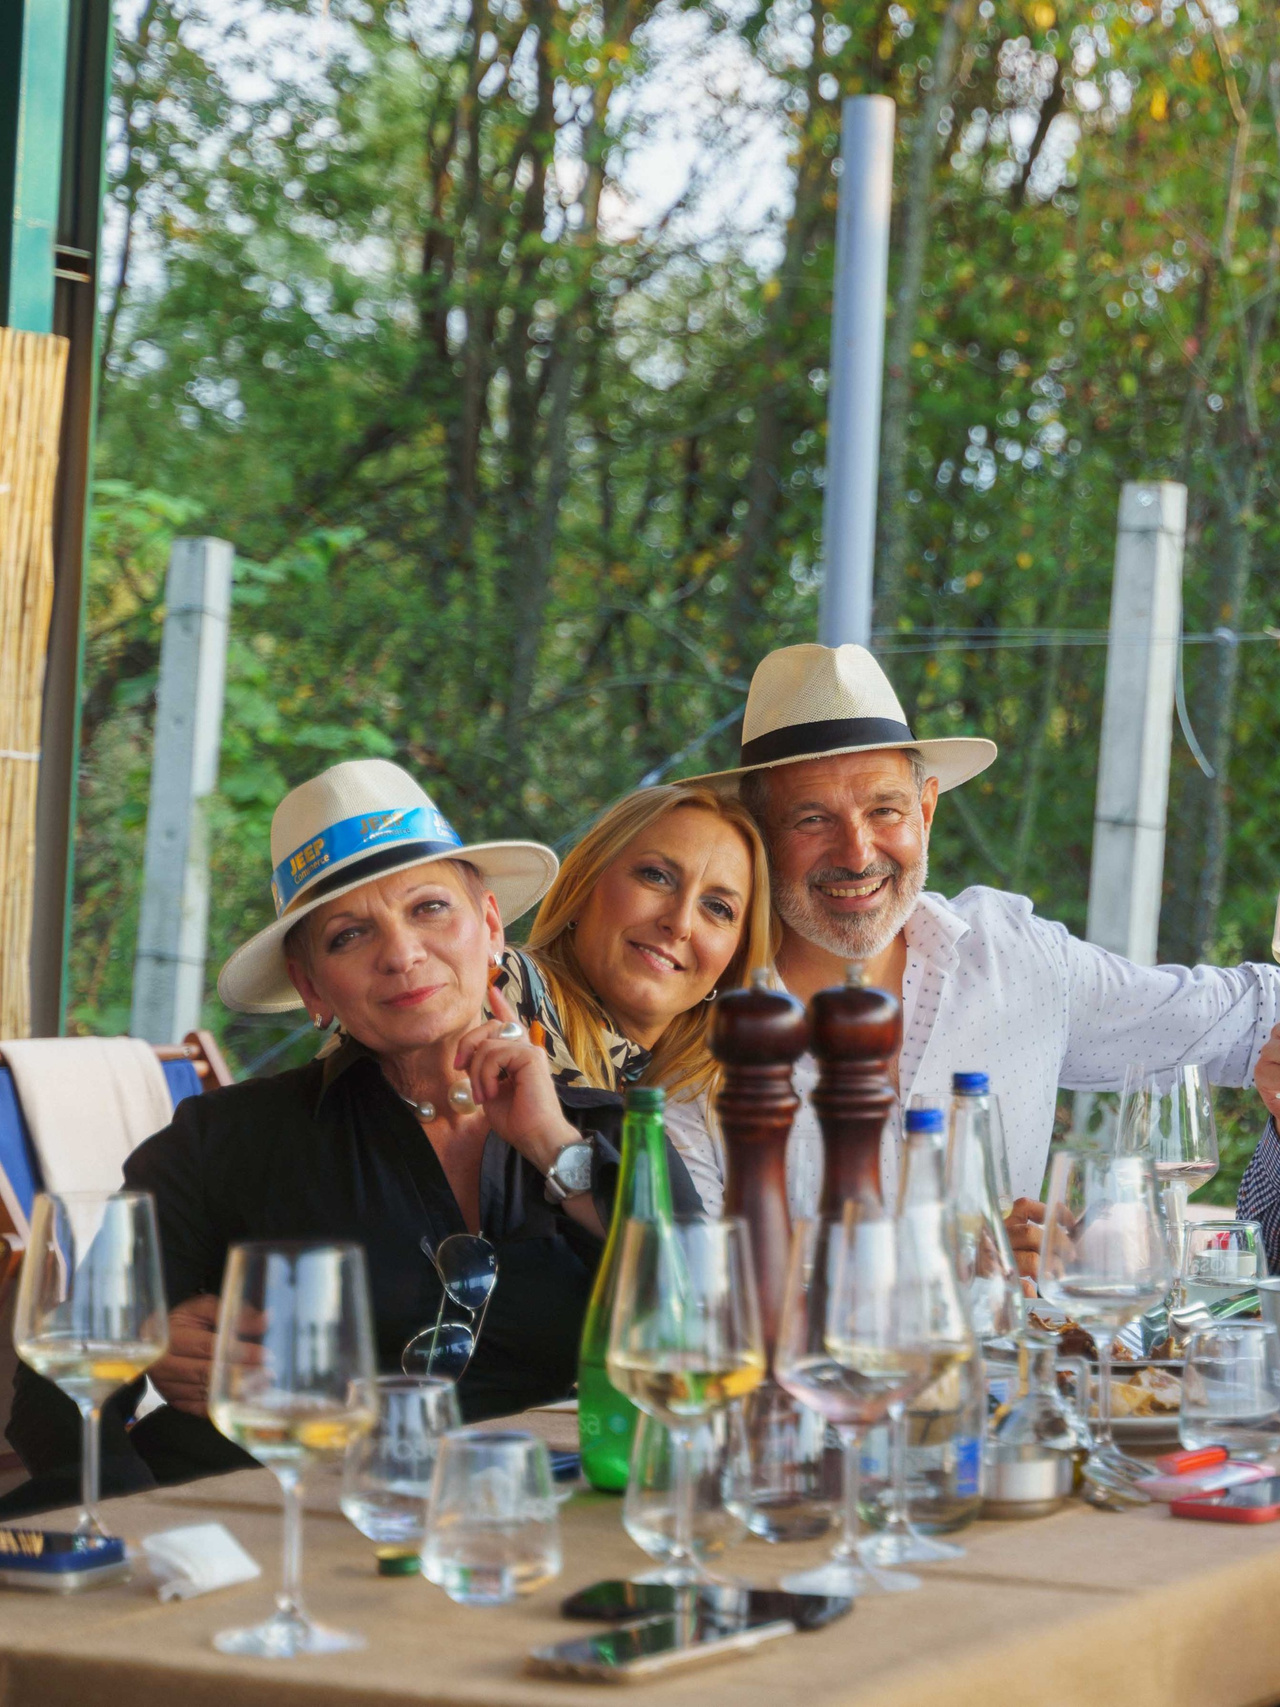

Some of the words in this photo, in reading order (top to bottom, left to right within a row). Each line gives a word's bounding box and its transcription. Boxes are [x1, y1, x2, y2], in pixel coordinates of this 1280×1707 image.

[360, 813, 404, 834] JEEP
[290, 838, 325, 876] JEEP
[294, 854, 330, 885] Commerce
